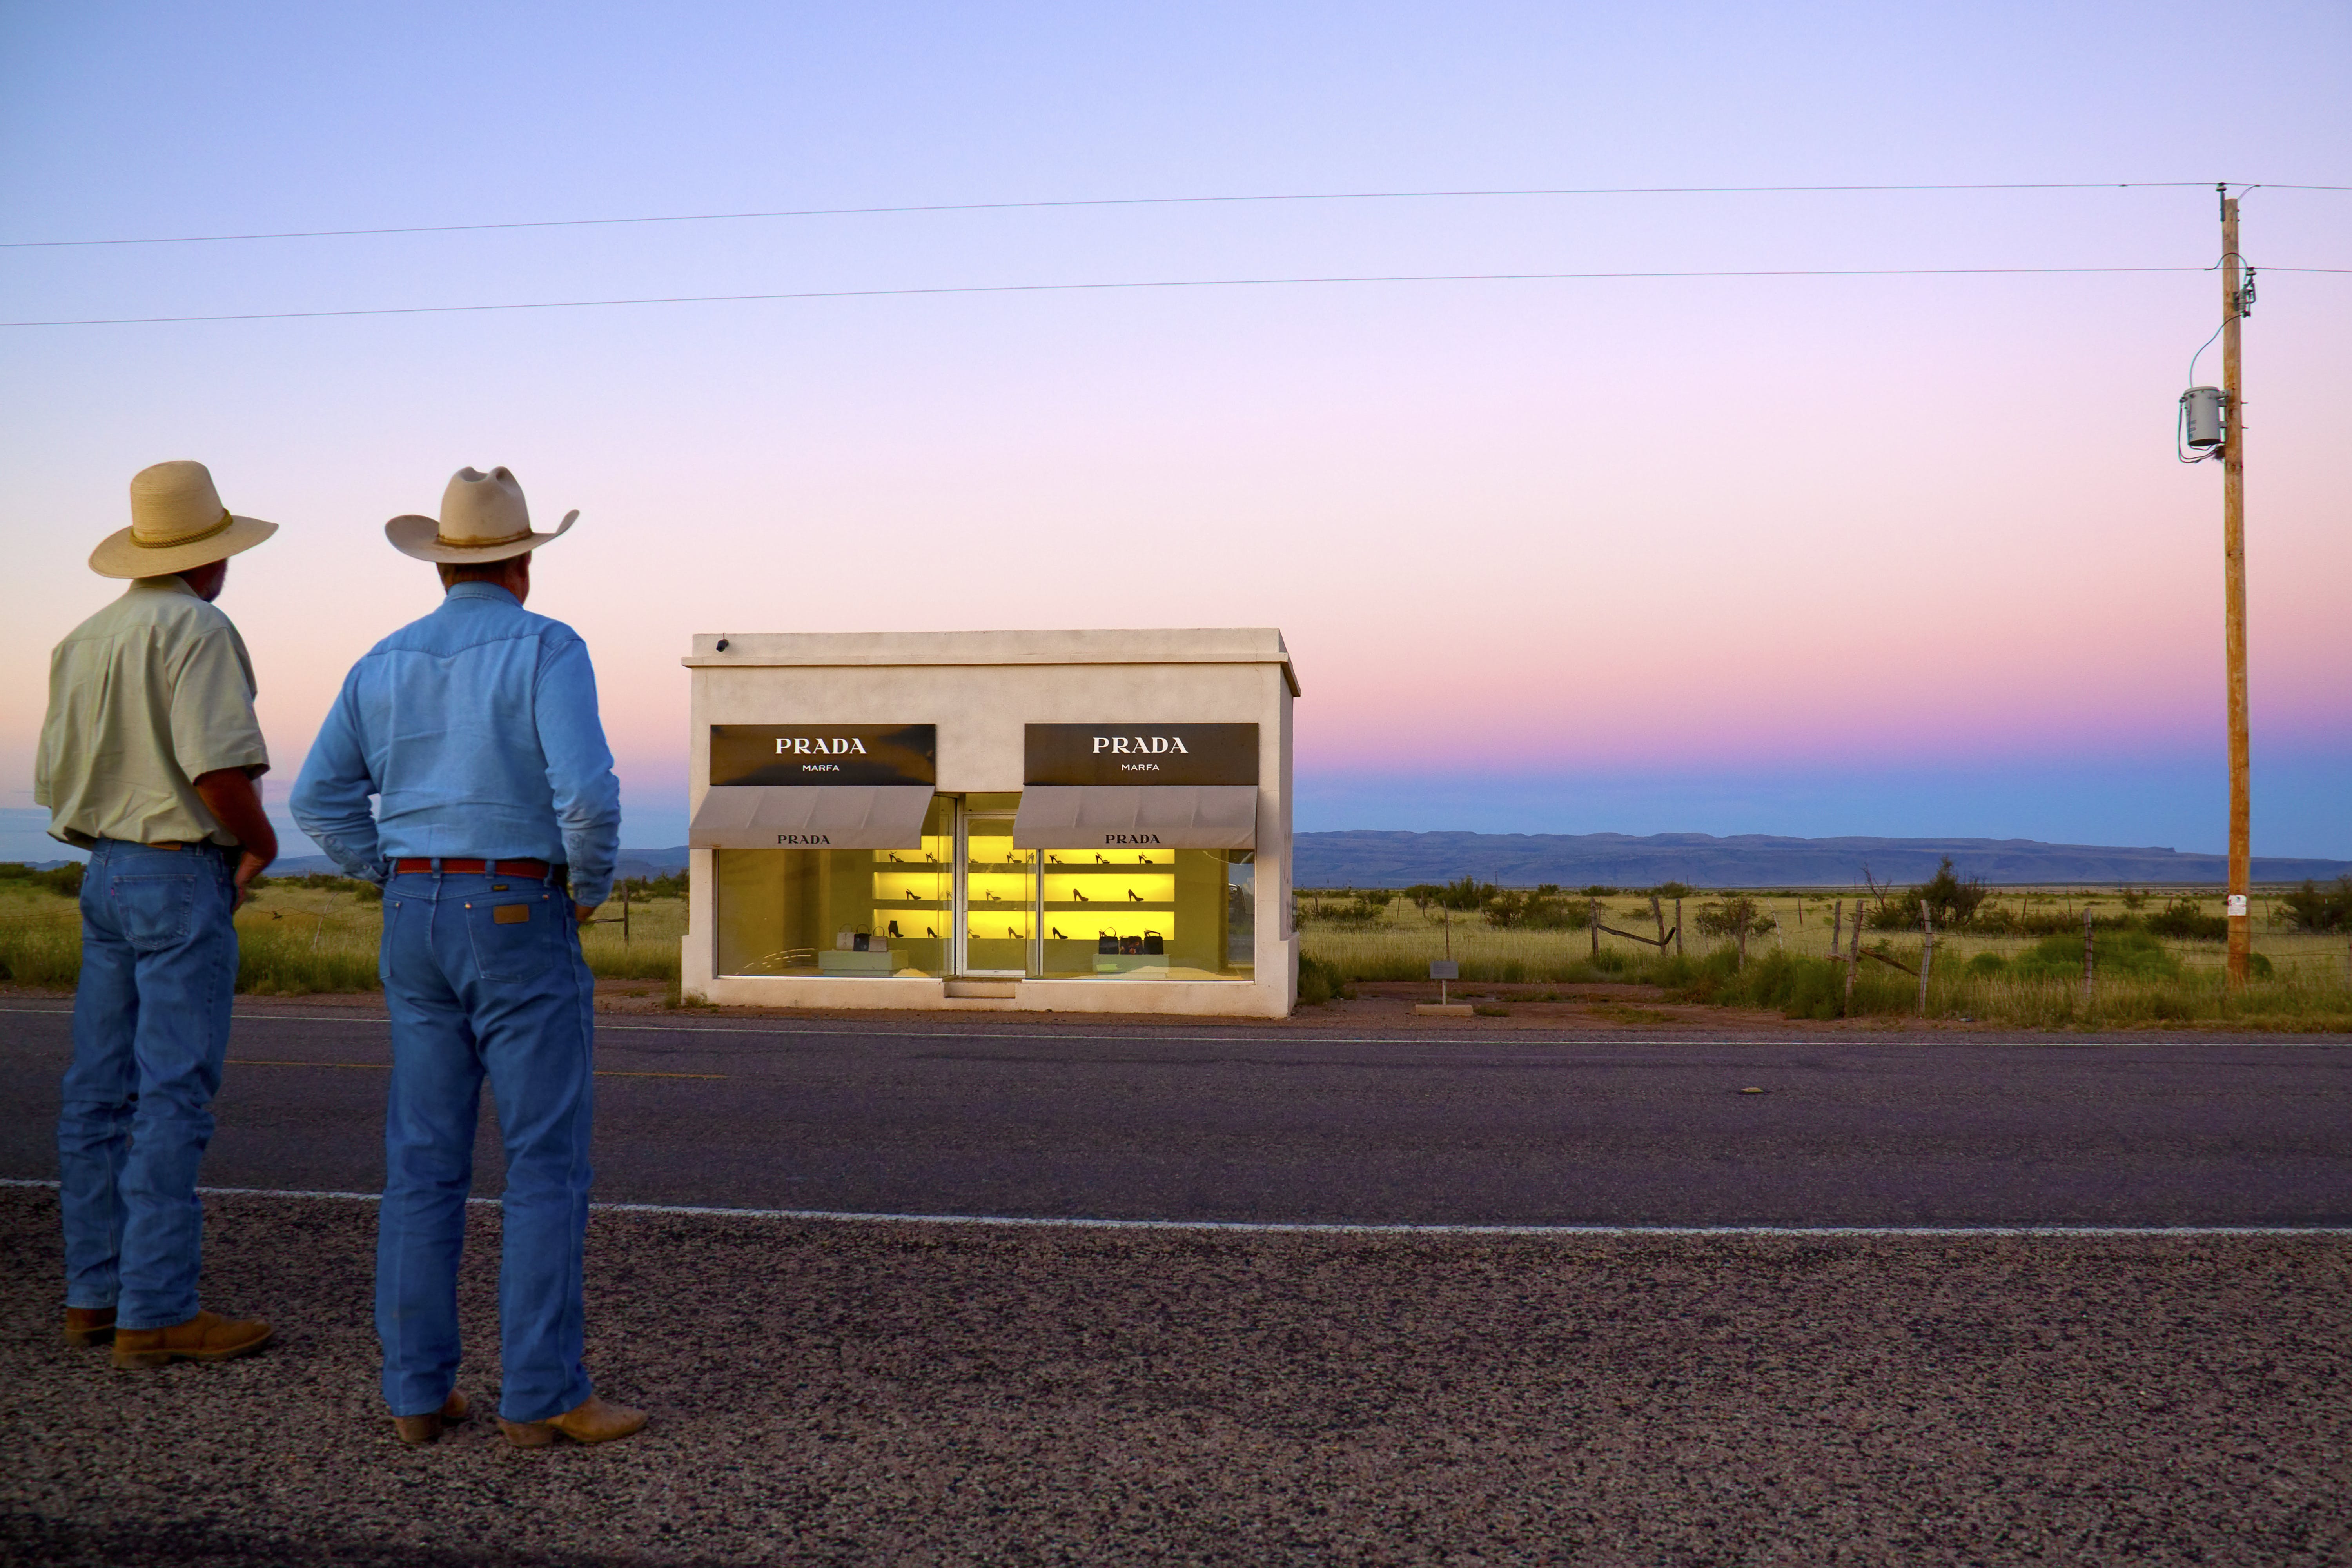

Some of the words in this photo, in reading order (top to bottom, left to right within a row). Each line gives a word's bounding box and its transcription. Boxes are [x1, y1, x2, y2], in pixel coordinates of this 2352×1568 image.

[776, 738, 867, 754] PRADA
[1093, 737, 1189, 753] PRADA
[777, 835, 831, 844] PRADA
[1105, 834, 1161, 844] PRADA
